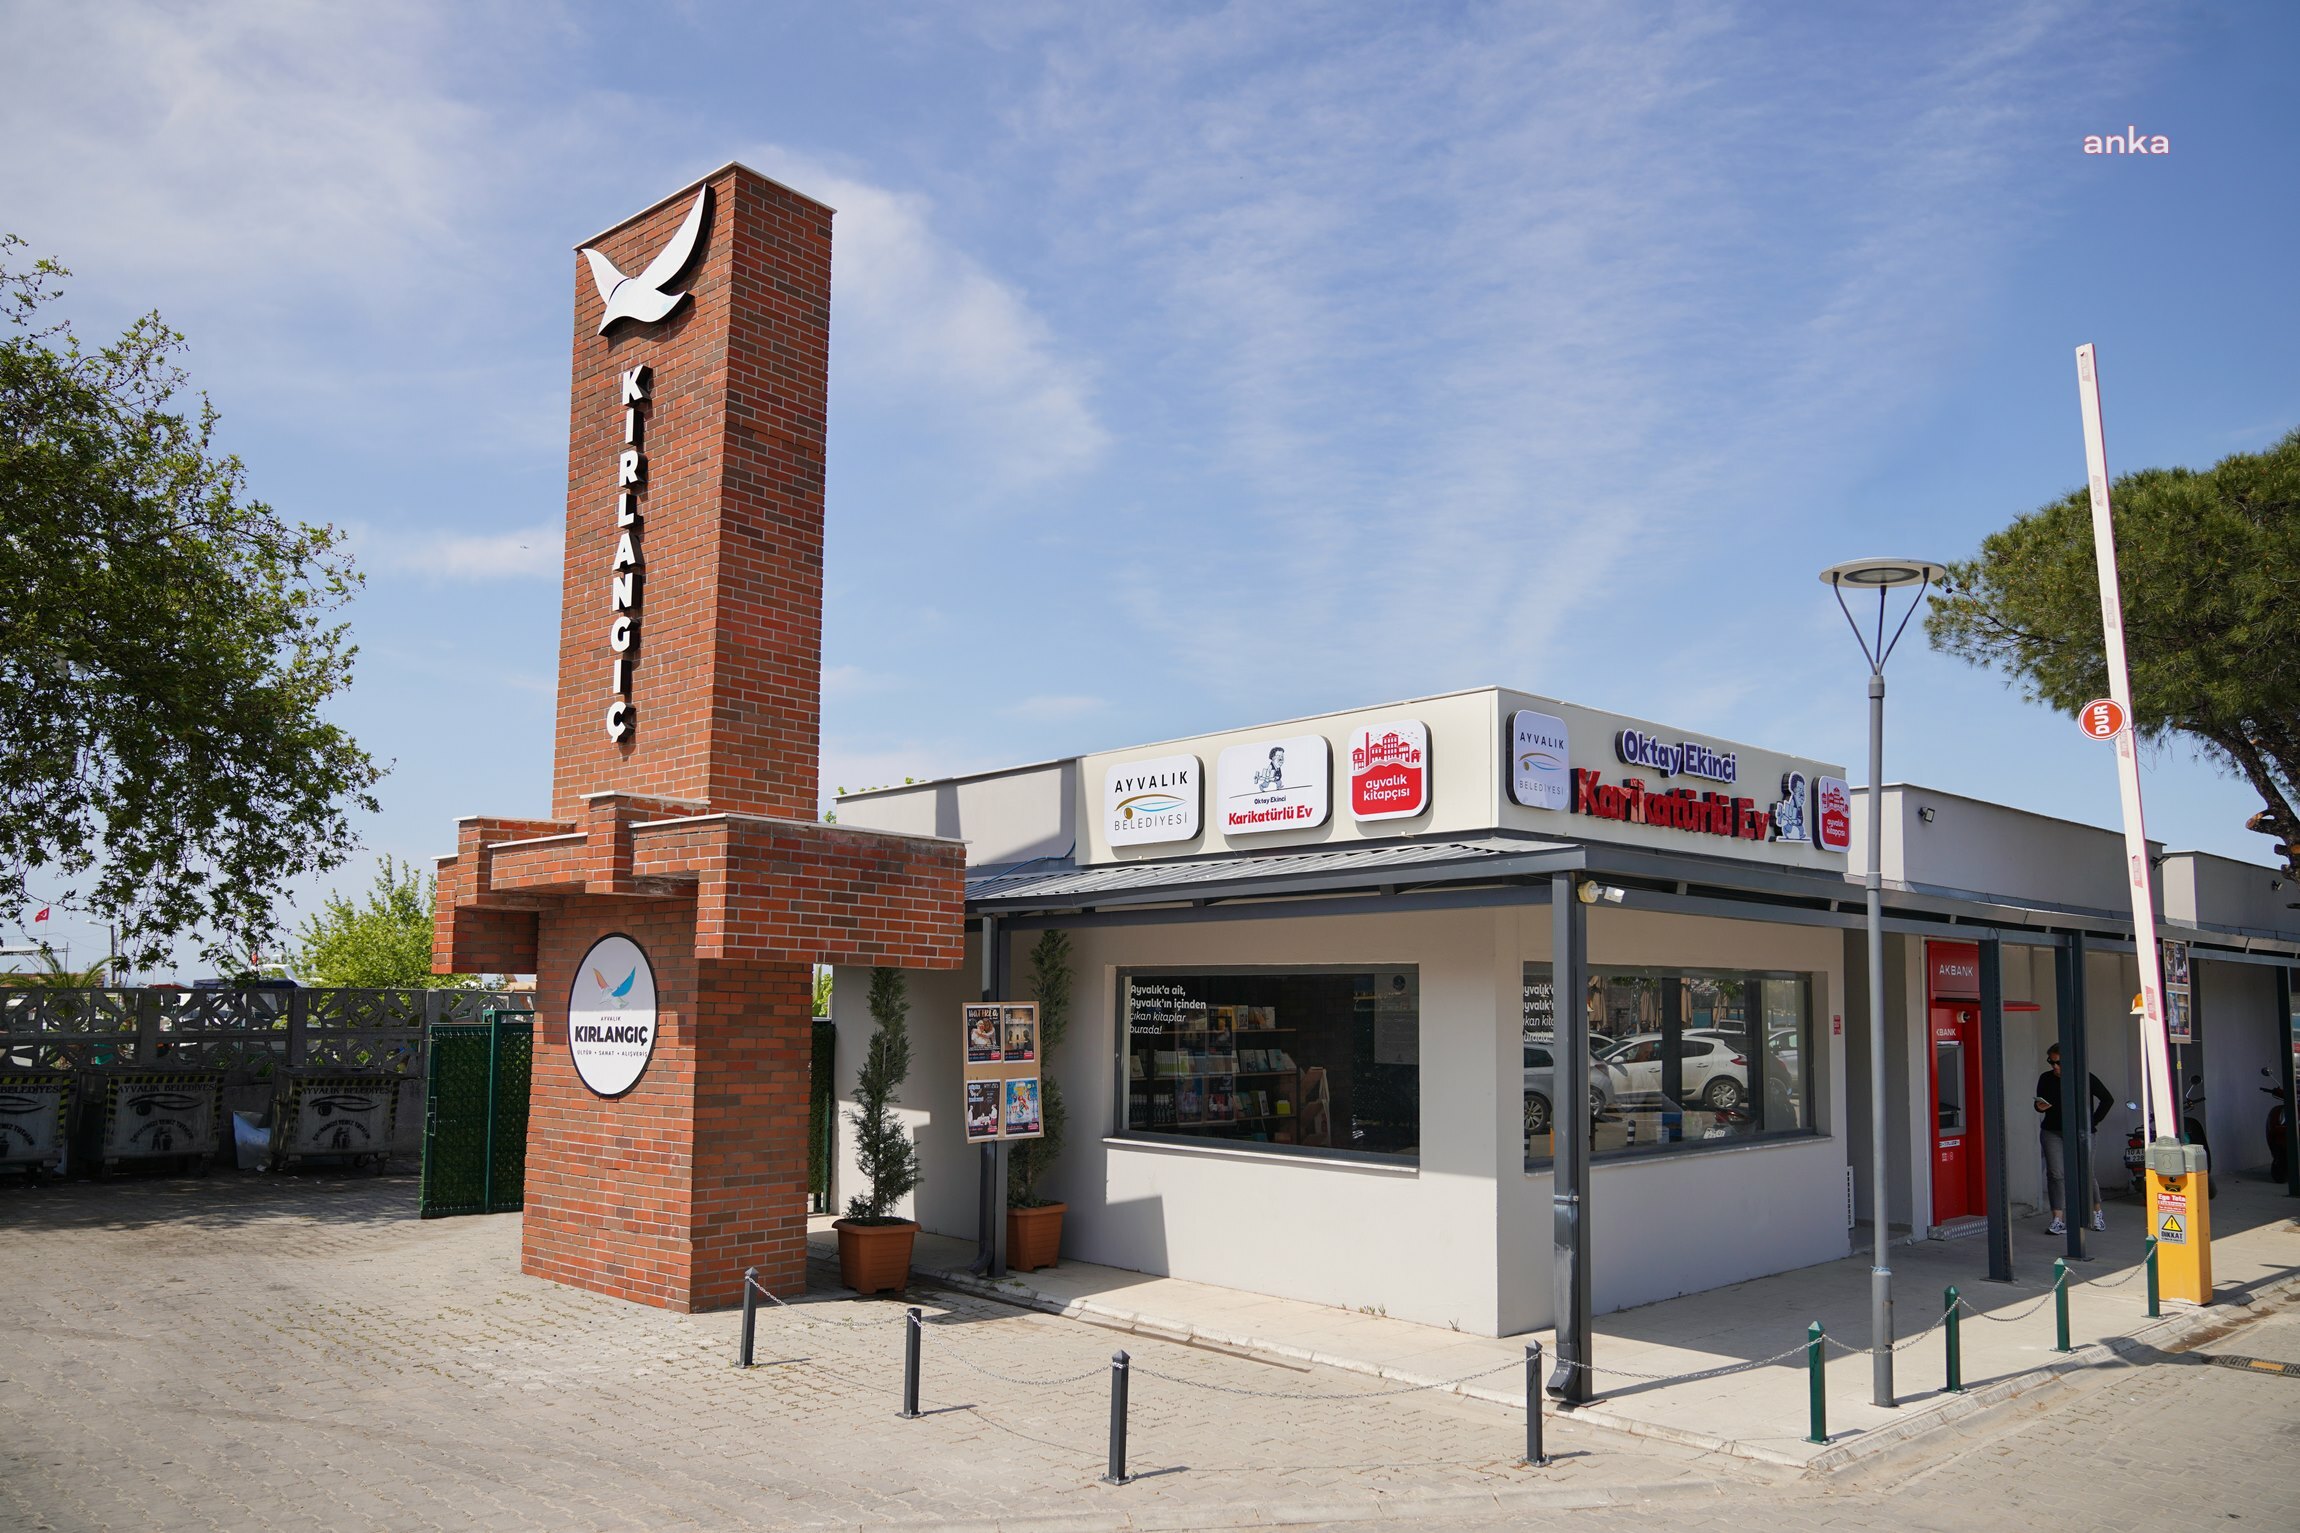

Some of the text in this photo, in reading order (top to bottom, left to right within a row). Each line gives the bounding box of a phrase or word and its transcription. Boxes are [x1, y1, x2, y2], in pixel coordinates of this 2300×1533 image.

[606, 364, 646, 743] KIRLANGIÇ
[2093, 705, 2110, 735] DUR
[1520, 731, 1564, 750] AYVALIK
[1622, 728, 1738, 783] Oktay Ekinci
[1114, 771, 1188, 793] AYVALIK
[1365, 774, 1407, 790] ayvalık
[1254, 795, 1286, 805] Oktay Ekinci
[1363, 788, 1410, 801] kitapçısı
[1576, 767, 1770, 840] Karikatürlü Ev
[1114, 811, 1187, 831] BELEDİYESİ
[1228, 805, 1313, 826] Karikatürlü Ev
[1939, 964, 1974, 977] AKBANK
[1130, 984, 1186, 997] Ayvalık'a ait,
[1129, 998, 1207, 1011] Ayvalık'ın içinden
[1129, 1011, 1186, 1023] çıkan kitaplar
[1523, 1015, 1540, 1026] kan
[1129, 1024, 1163, 1035] burada!
[1936, 1028, 1957, 1036] KBANK
[575, 1026, 648, 1047] KIRLANGIÇ
[118, 1084, 160, 1093] AYVALIK
[301, 1087, 340, 1095] AYVALIK
